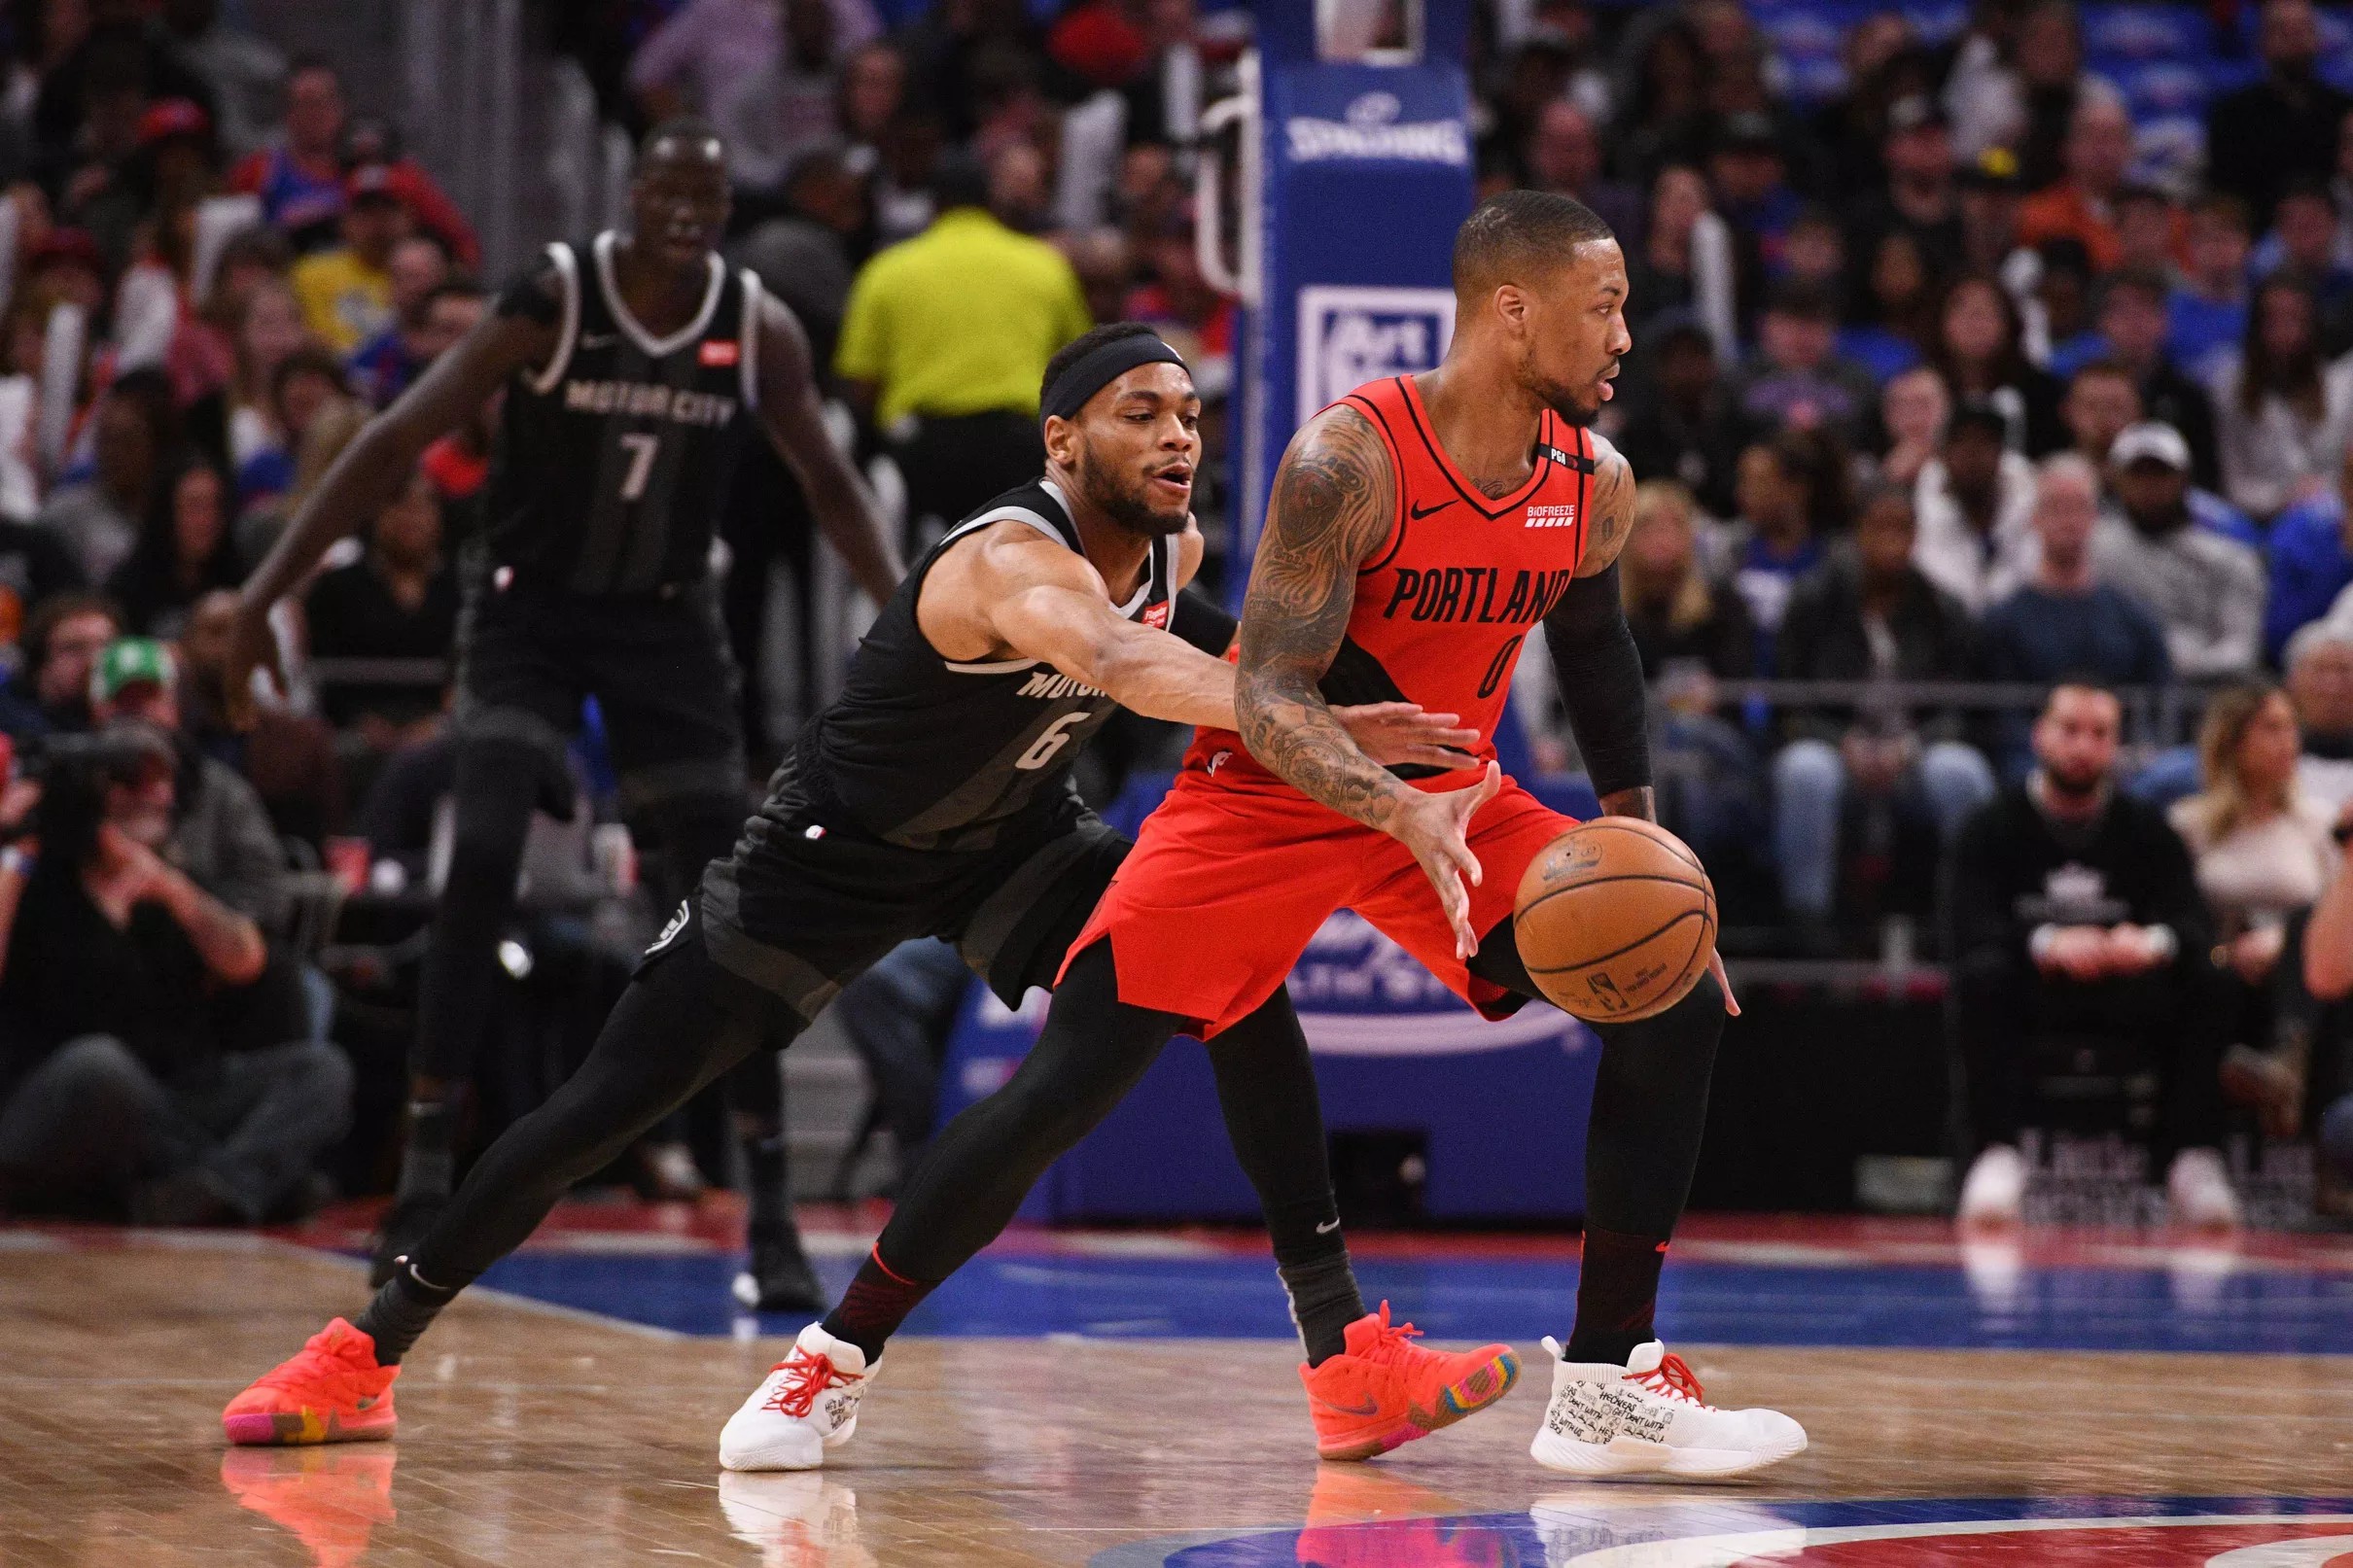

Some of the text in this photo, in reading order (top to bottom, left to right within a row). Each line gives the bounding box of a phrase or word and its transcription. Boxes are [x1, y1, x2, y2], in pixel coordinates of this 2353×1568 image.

[1286, 116, 1467, 164] SPALDING
[565, 380, 736, 427] MOTOR CITY
[619, 434, 658, 500] 7
[1551, 448, 1566, 466] PGA
[1383, 567, 1570, 624] PORTLAND
[1477, 634, 1523, 699] 0
[1015, 712, 1092, 770] 6
